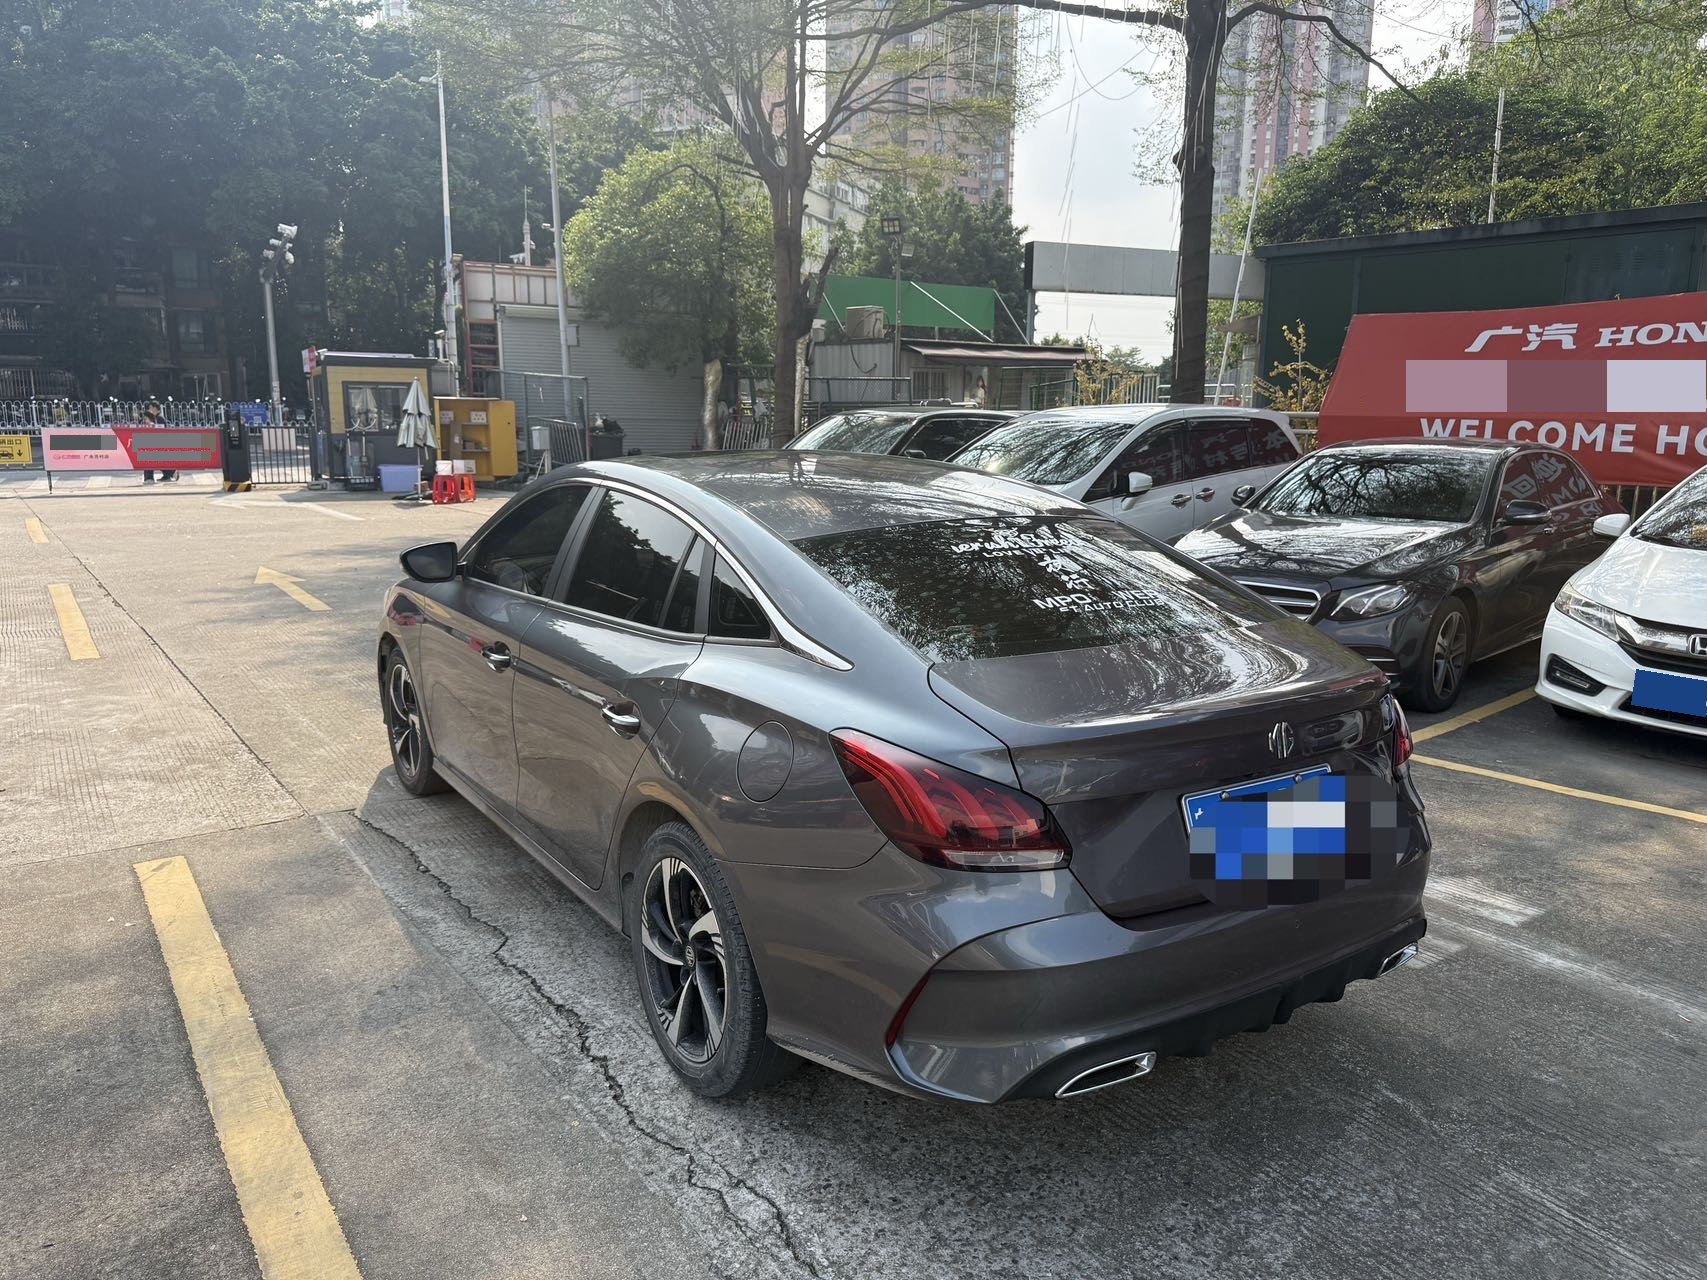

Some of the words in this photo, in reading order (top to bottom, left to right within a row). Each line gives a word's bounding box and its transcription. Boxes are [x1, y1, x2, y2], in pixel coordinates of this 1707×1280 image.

[1464, 322, 1579, 353] 广汽
[1085, 601, 1124, 612] AUTO
[1125, 598, 1164, 608] CLUB
